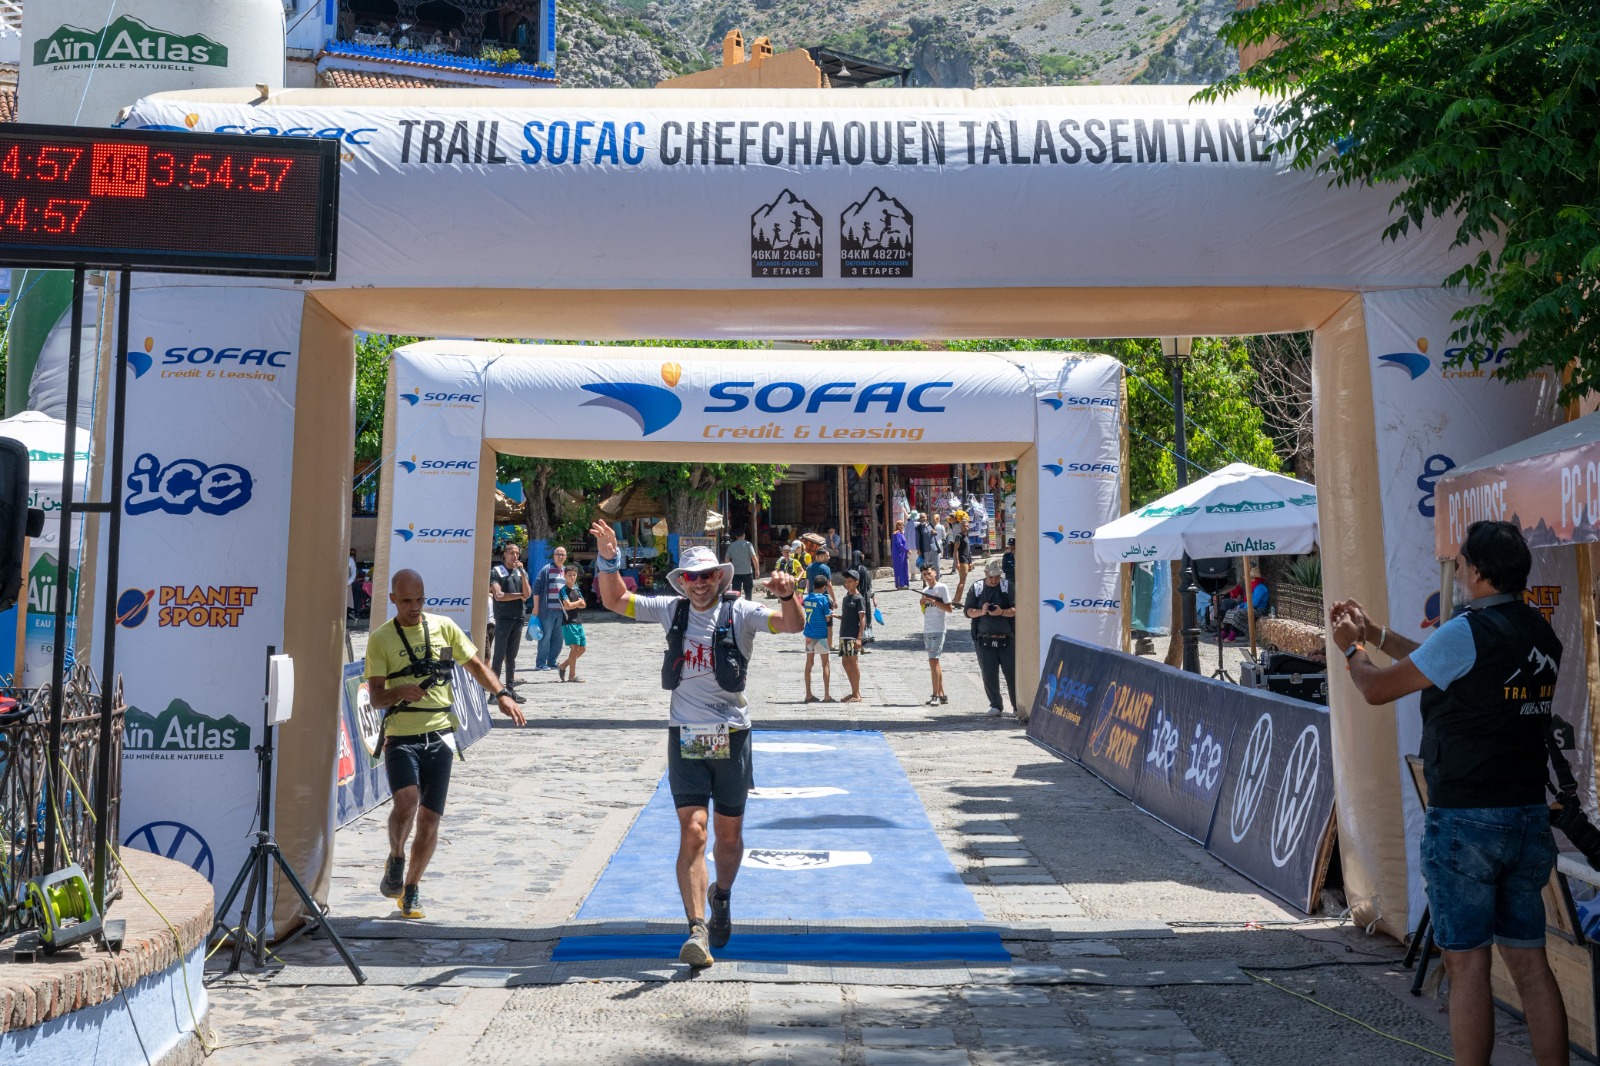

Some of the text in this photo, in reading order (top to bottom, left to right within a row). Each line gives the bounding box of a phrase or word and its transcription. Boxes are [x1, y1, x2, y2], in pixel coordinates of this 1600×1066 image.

[43, 29, 210, 63] Aïn Atlas
[129, 63, 195, 72] NATURELLE
[399, 118, 1272, 166] TRAIL SOFAC CHEFCHAOUEN TALASSEMTANE
[98, 148, 143, 187] 46
[152, 153, 293, 192] 3:54:57
[0, 197, 90, 234] 4:57
[752, 249, 822, 260] 46KM 2646D+
[841, 249, 912, 260] 84KM 4827D+
[763, 267, 811, 275] 2 ETAPES
[851, 267, 901, 275] 3 ETAPES
[161, 347, 292, 368] SOFAC
[161, 368, 276, 382] Crédit & Leasing
[423, 392, 482, 403] SOFAC
[703, 381, 954, 413] SOFAC
[1067, 397, 1118, 407] SOFAC
[703, 422, 925, 442] Crédit & Leasing
[420, 460, 478, 470] SOFAC
[1068, 463, 1119, 473] SOFAC
[127, 454, 250, 512] ice
[1561, 464, 1582, 528] PC
[1240, 503, 1280, 512] Atlas
[1448, 493, 1461, 545] PC
[1463, 480, 1507, 530] COURSE
[417, 528, 474, 538] SOFAC
[158, 585, 258, 607] PLANET
[1069, 598, 1120, 608] SOFAC
[35, 619, 52, 628] EAU
[158, 606, 244, 629] SPORT
[1057, 676, 1094, 708] SOFAC
[1116, 684, 1153, 730] PLANET
[160, 714, 236, 749] Atlas
[700, 735, 726, 747] 1109
[137, 751, 174, 760] MINÉRALE
[1105, 724, 1139, 769] SPORT
[1184, 723, 1222, 791] ice
